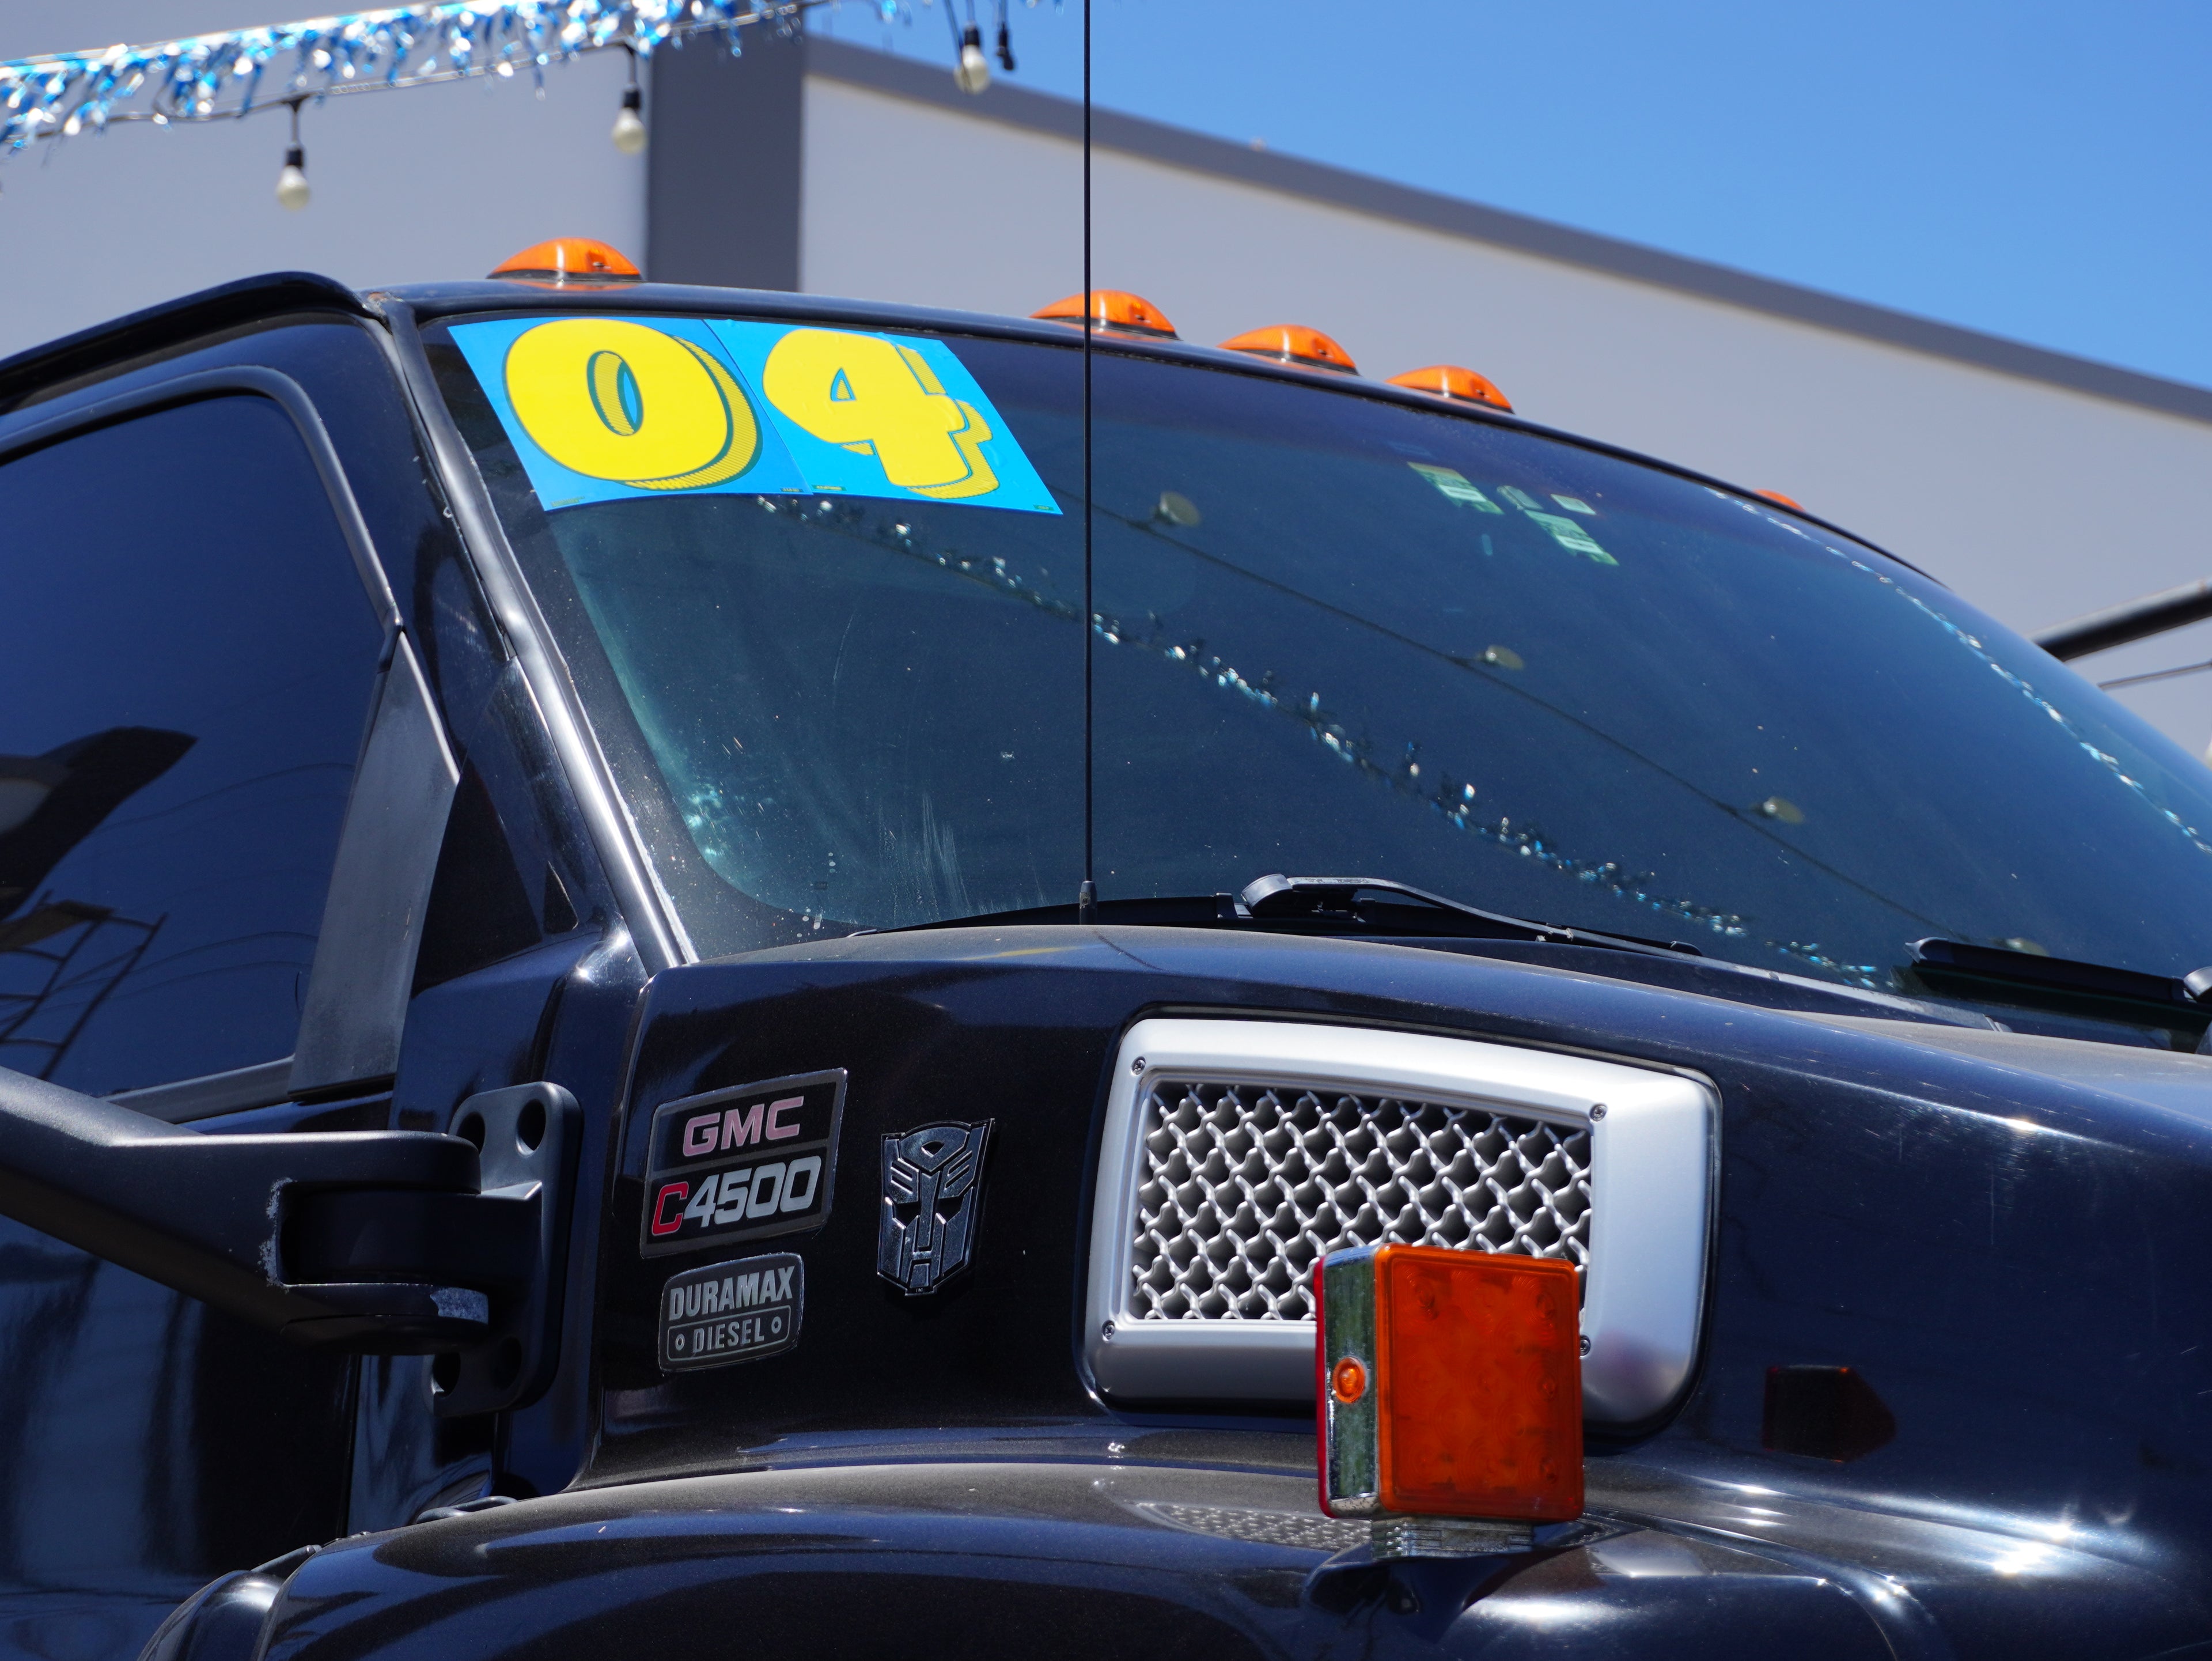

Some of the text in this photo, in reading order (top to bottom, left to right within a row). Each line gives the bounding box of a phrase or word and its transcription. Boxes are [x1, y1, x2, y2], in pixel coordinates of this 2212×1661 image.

[502, 318, 1000, 500] 04
[683, 1095, 804, 1157] GMC
[652, 1155, 822, 1236] C4500
[668, 1265, 796, 1321] DURAMAX
[692, 1317, 765, 1353] DIESEL
